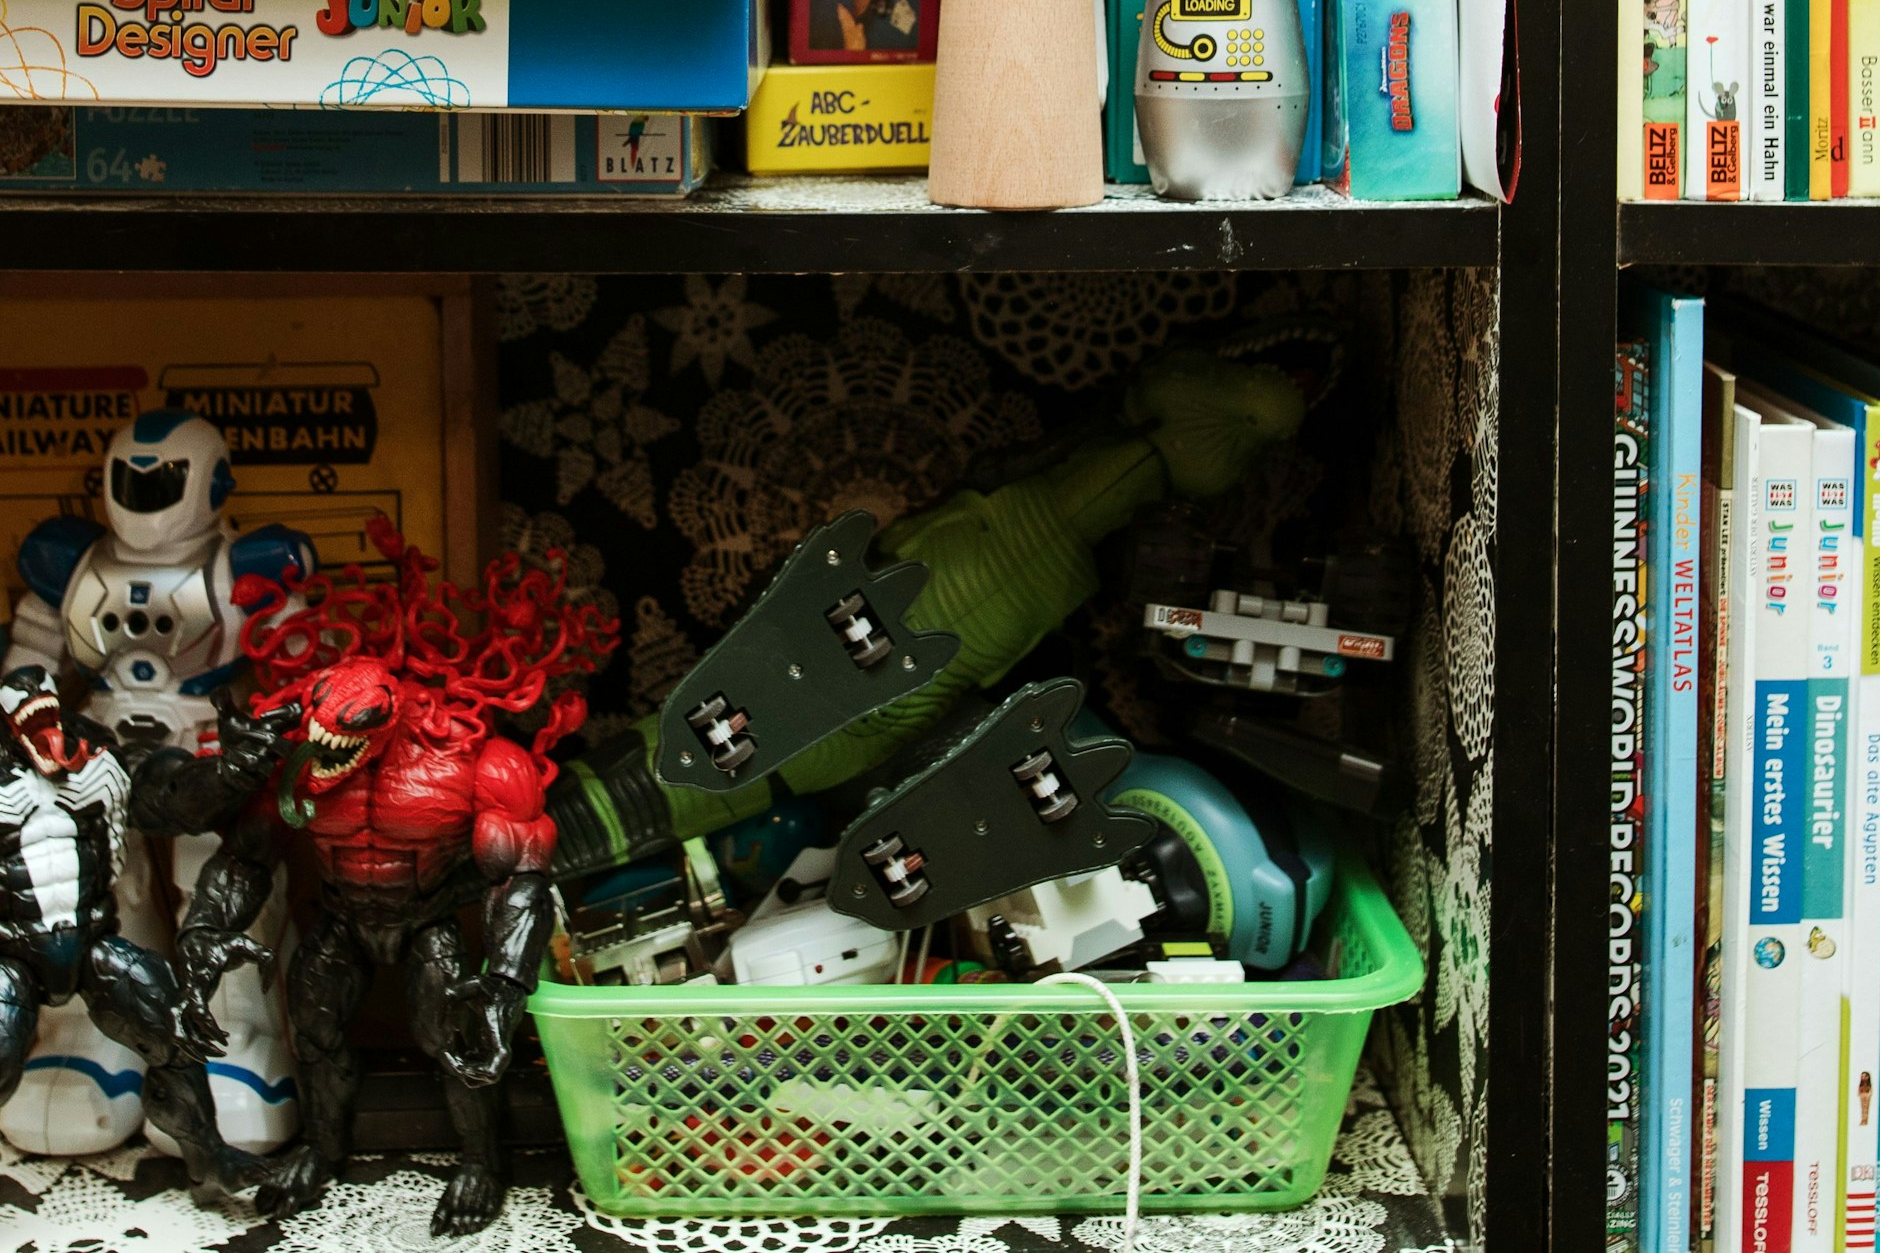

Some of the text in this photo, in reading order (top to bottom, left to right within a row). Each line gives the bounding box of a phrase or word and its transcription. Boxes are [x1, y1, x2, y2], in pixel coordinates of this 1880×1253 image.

[77, 4, 297, 76] Designer
[1764, 3, 1777, 33] war
[1388, 11, 1414, 131] DRAGONS
[1764, 40, 1780, 101] einmal
[778, 120, 930, 148] ZAUBERDUELL
[1764, 106, 1779, 130] ein
[87, 148, 132, 184] 64
[606, 156, 675, 174] BLATZ
[1650, 127, 1666, 185] BELTZ
[1666, 127, 1677, 176] Gelberg
[1711, 126, 1727, 183] BELTZ
[1727, 126, 1739, 173] Gelberg
[1764, 136, 1779, 181] Hahn
[183, 389, 353, 417] MINIATUR
[1766, 519, 1794, 615] Junior
[1817, 519, 1845, 615] Junior
[1812, 695, 1842, 851] Dinosaurier
[1669, 472, 1697, 1174] Kinder WELTATLAS Schwager
[1761, 693, 1790, 914] Mein erstes Wissen
[1758, 1099, 1772, 1151] Wissen
